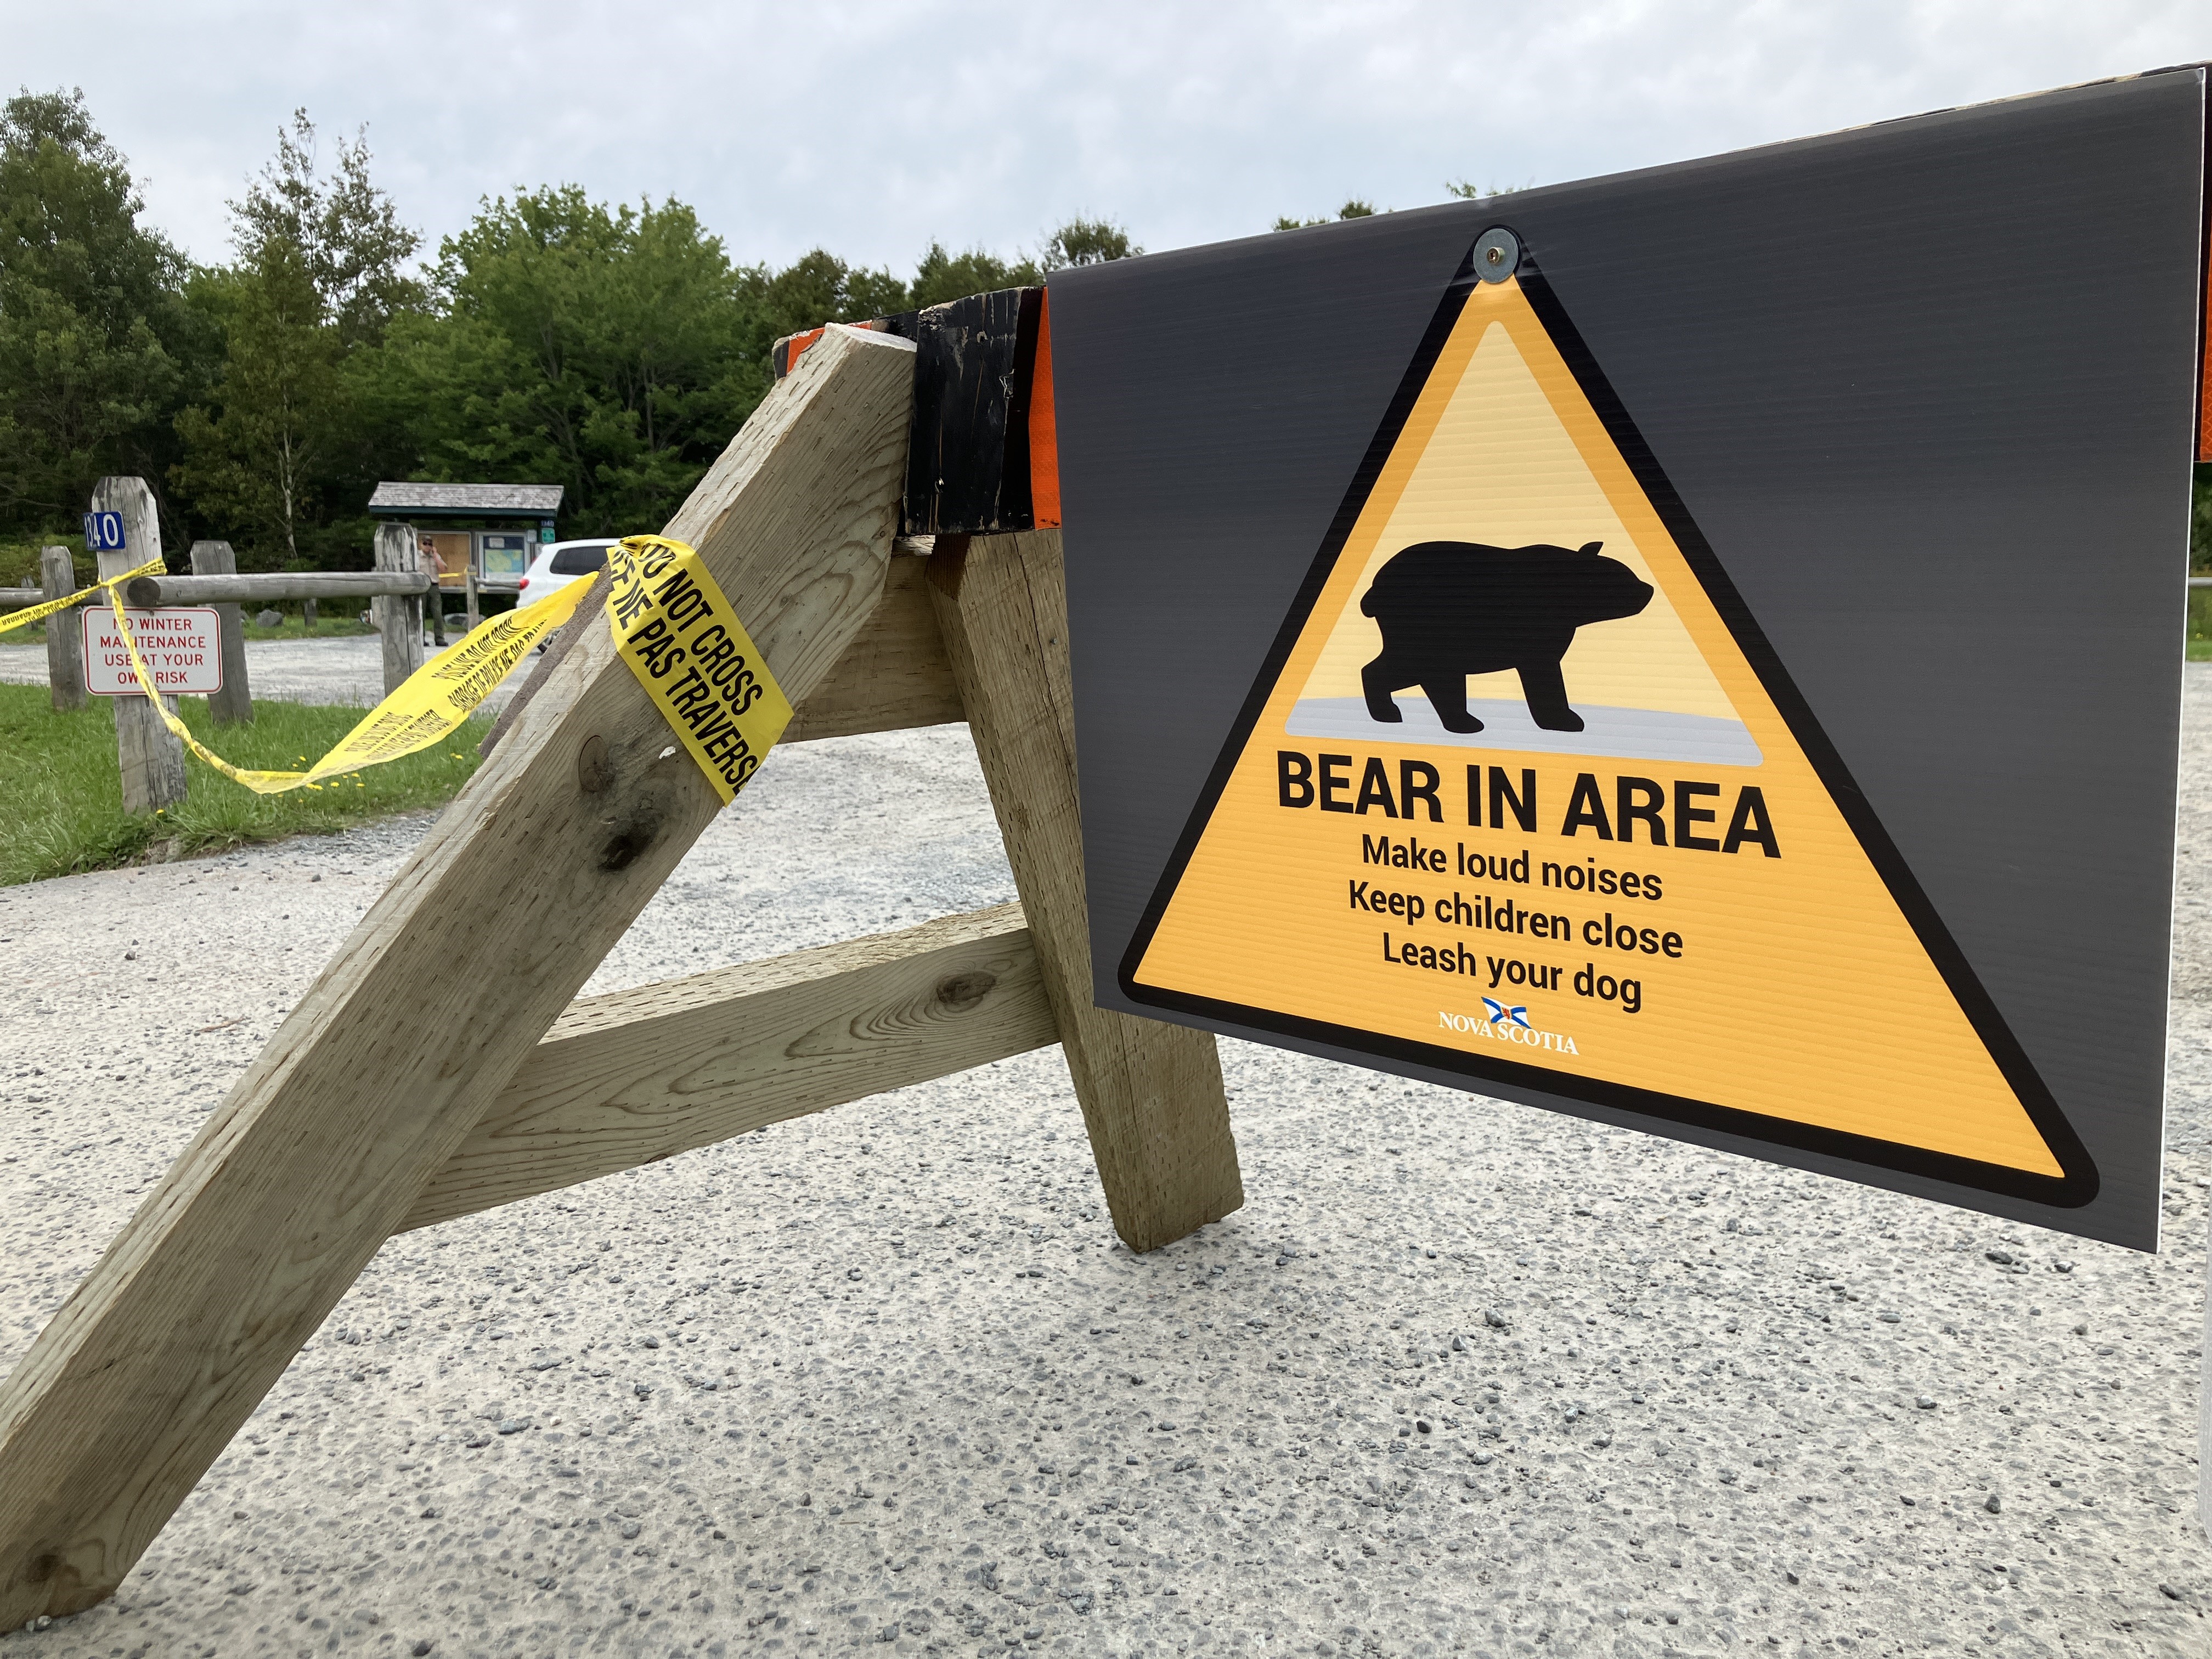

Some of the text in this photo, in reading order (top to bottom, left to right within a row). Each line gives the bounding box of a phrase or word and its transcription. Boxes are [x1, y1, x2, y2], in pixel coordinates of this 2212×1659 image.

[139, 618, 192, 630] WINTER
[612, 577, 653, 631] NE
[100, 636, 206, 648] MATENANCE
[105, 654, 204, 666] USE AT YOUR
[627, 617, 686, 679] PAS
[652, 568, 714, 633] NOT
[691, 624, 763, 716] CROSS
[117, 672, 188, 684] OW RISK
[1277, 750, 1781, 859] BEAR IN AREA
[1362, 833, 1662, 900] Make loud noises
[1350, 879, 1683, 958] Keep children close
[1383, 932, 1641, 1013] Leash your dog
[1438, 1011, 1579, 1055] NOVA SCOTIA
